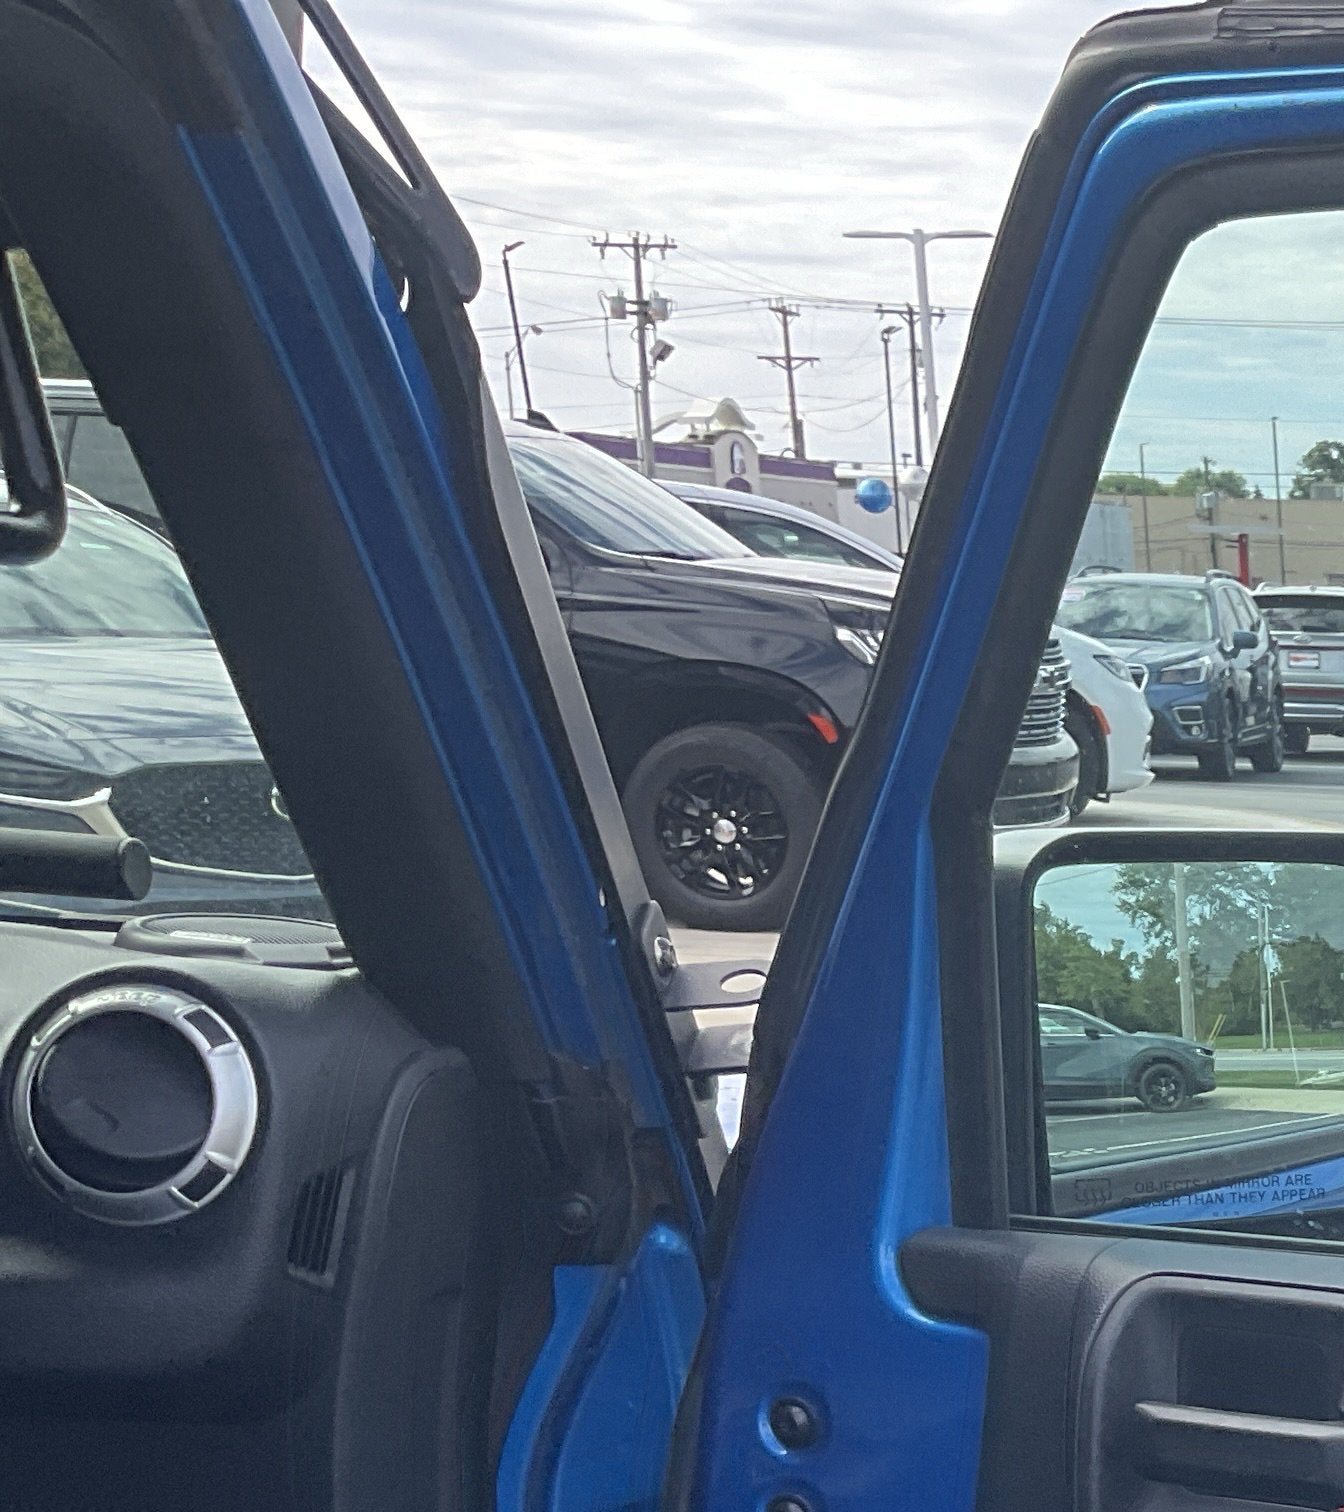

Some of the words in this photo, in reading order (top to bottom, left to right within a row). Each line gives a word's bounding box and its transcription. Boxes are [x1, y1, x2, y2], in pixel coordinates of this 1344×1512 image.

[1134, 1178, 1202, 1194] OBJECTS
[1284, 1173, 1313, 1187] ARE
[1187, 1192, 1225, 1205] THAN
[1229, 1190, 1266, 1204] THEY
[1271, 1187, 1326, 1202] APPEAR
